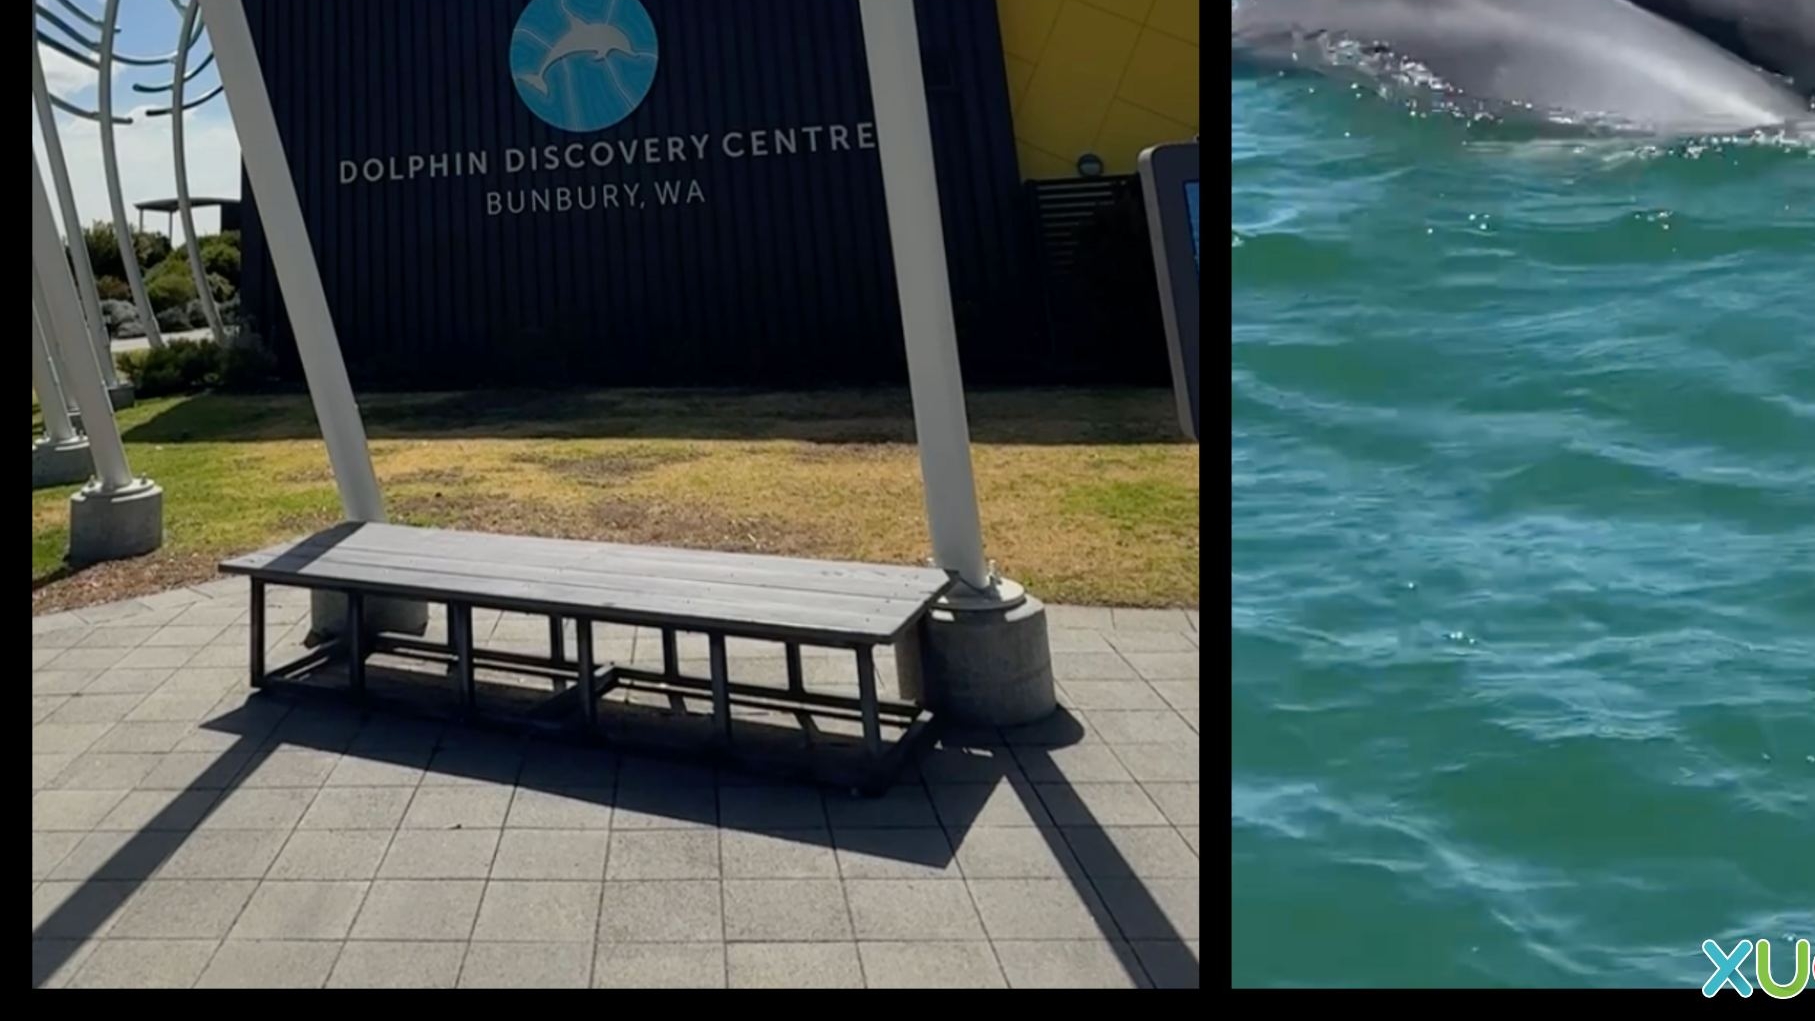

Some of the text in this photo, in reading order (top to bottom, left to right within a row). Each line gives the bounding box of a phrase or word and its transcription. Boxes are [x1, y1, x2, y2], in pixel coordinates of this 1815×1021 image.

[340, 122, 876, 184] DOLPHIN DISCOVERY CENTRE
[487, 179, 705, 216] BUNBURY, WA
